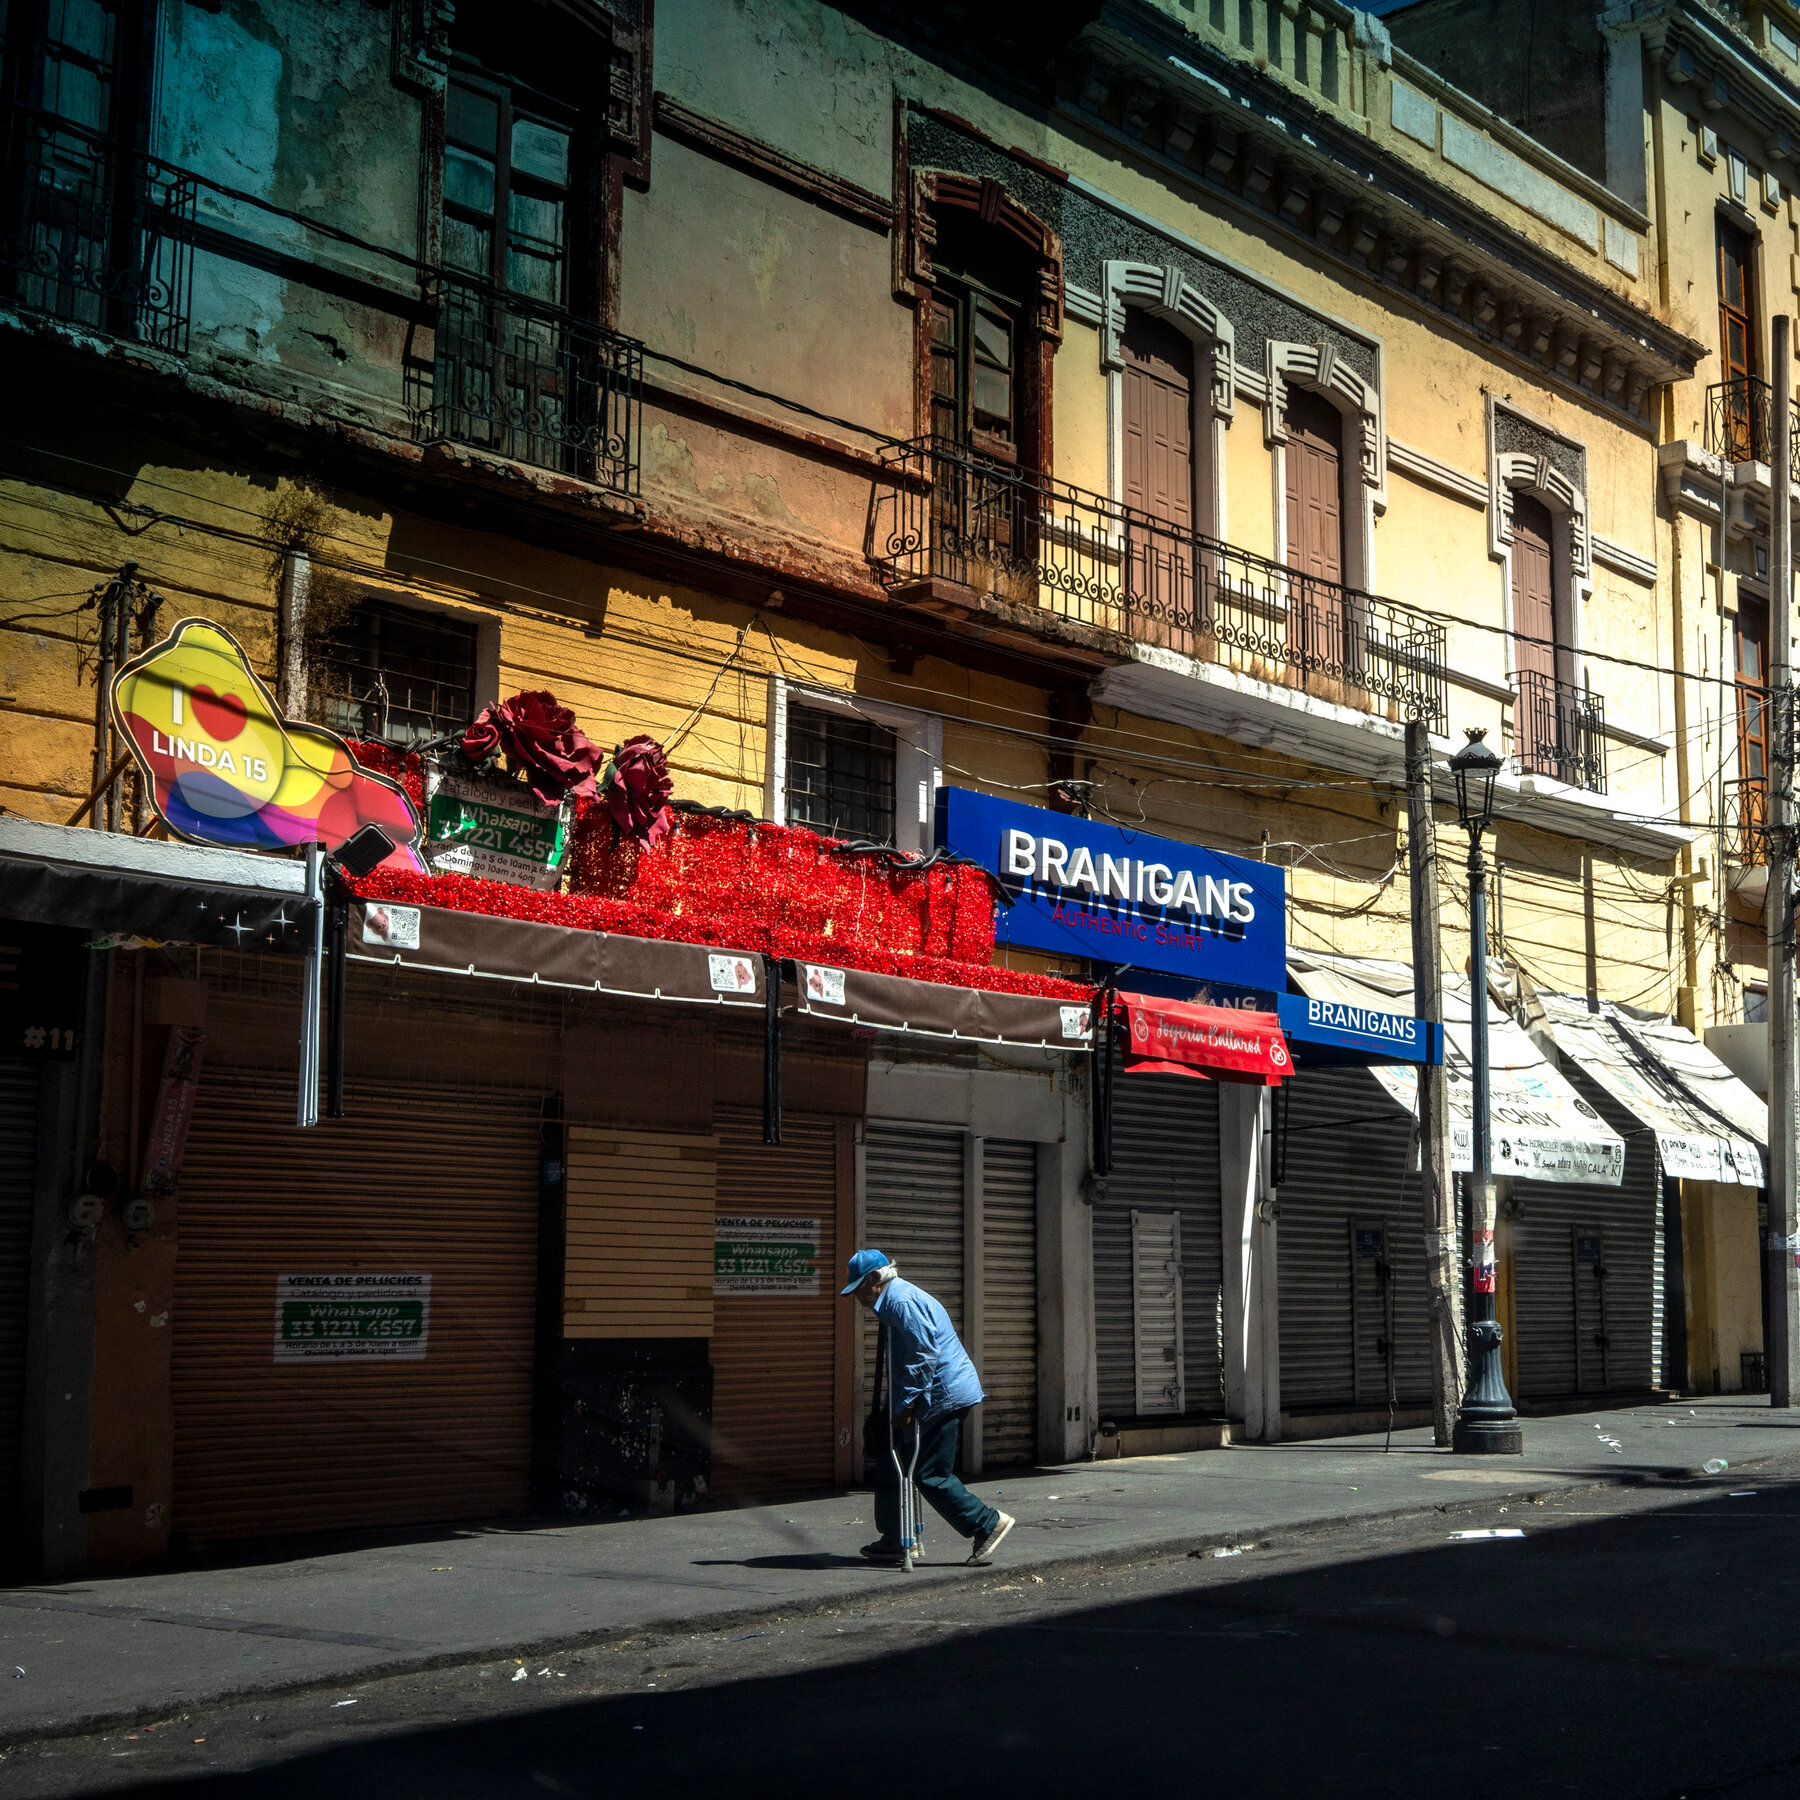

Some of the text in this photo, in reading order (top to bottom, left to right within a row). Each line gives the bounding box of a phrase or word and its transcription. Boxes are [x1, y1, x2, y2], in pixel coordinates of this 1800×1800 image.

[172, 682, 183, 725] I
[153, 730, 267, 783] LINDA 15
[500, 795, 508, 805] y
[459, 802, 543, 837] Whatsapp
[464, 825, 502, 849] 1221
[508, 835, 556, 861] 4557
[445, 853, 485, 872] Domingo
[488, 864, 509, 876] 10am
[518, 872, 536, 884] 4pm
[474, 850, 479, 859] L
[489, 854, 495, 863] S
[498, 855, 508, 866] de
[509, 856, 531, 872] 10am
[539, 865, 556, 877] 6pm
[1001, 829, 1255, 924] BRANIGANS
[1051, 904, 1205, 952] AUTHENTIC SHIRT
[1308, 999, 1416, 1040] BRANIGANS
[24, 1026, 74, 1051] #11
[1498, 1107, 1561, 1128] CHUY
[161, 1113, 176, 1155] LINDA
[715, 1218, 814, 1228] VENTA DE PELUCHES
[717, 1259, 809, 1273] 33 1221 4557
[288, 1276, 422, 1286] VENTA DE PELUCHES
[308, 1303, 399, 1319] Whatsapp
[290, 1319, 416, 1337] 33 1221 4557
